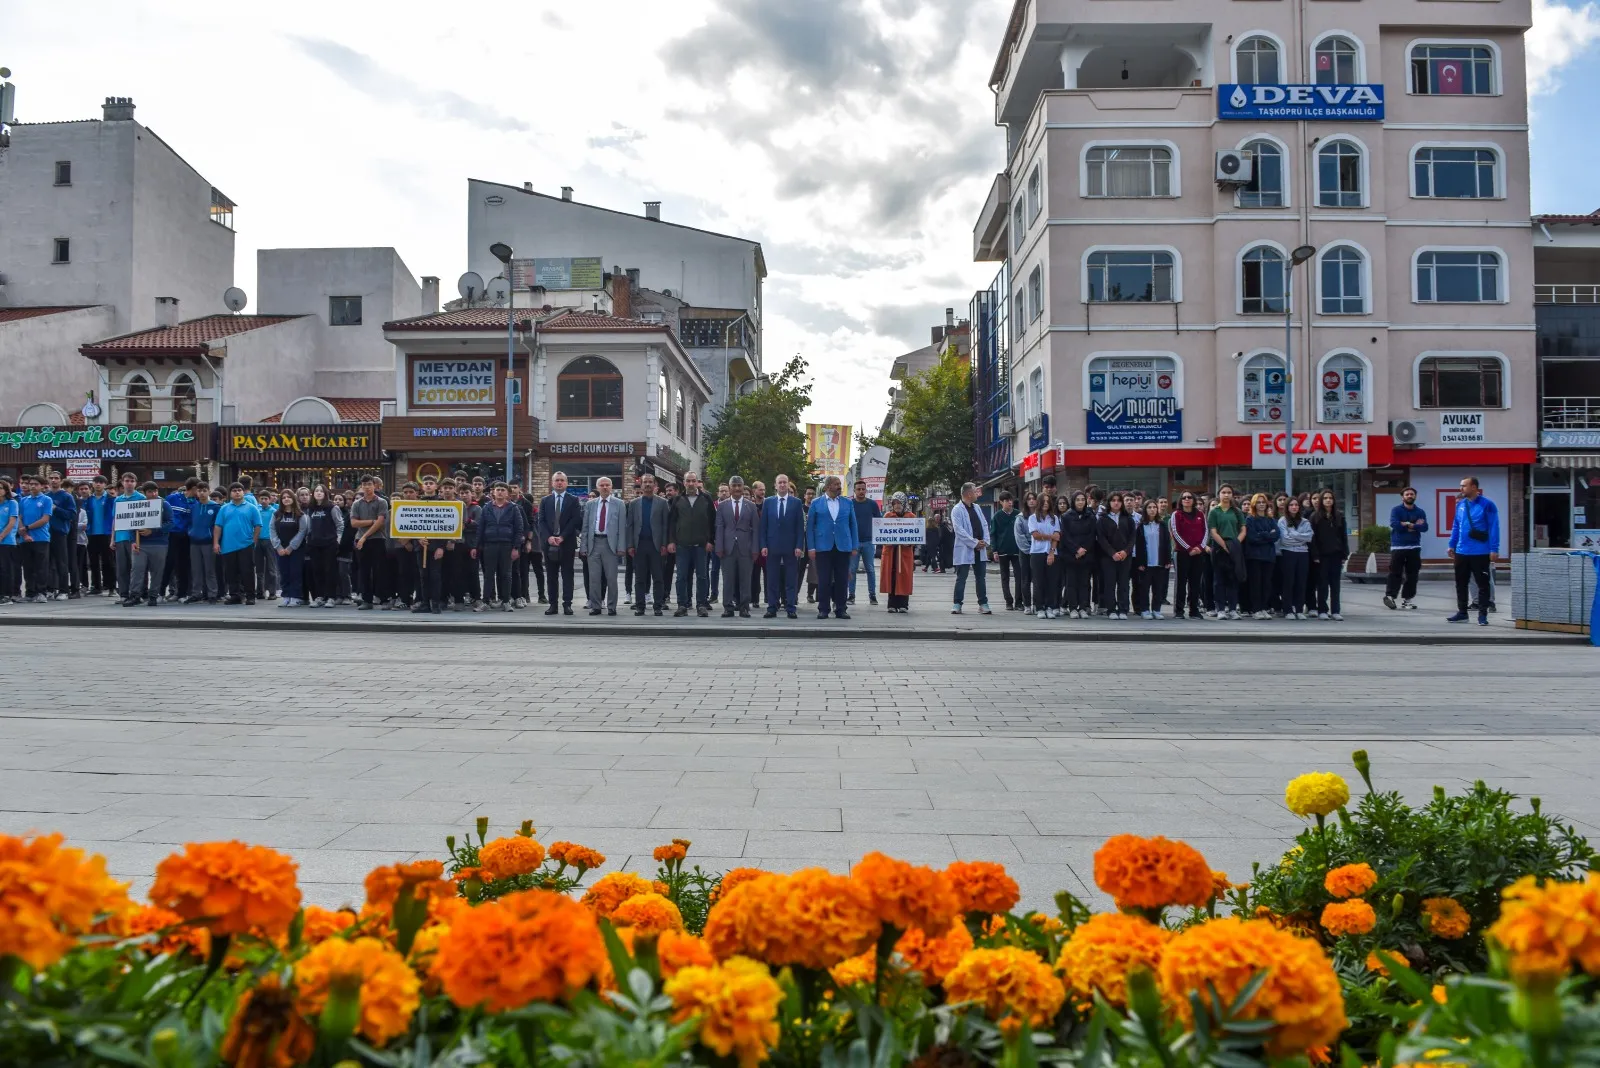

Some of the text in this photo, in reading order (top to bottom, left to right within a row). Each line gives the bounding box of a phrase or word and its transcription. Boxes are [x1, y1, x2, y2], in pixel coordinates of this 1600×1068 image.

[1252, 86, 1383, 105] DEVA
[1258, 107, 1376, 117] TAŞKÖPRÜ İLÇE BAŞKANLIĞI
[419, 362, 493, 373] MEYDAN
[418, 374, 493, 385] KIRTASİYE
[1112, 373, 1152, 389] hepiyi
[417, 386, 493, 402] FOTOKOPİ
[1126, 398, 1175, 417] MUMCU
[1442, 414, 1482, 425] AVUKAT
[0, 425, 194, 448] aşköprü Garlic
[413, 426, 498, 437] MEYDAN KIRTASİYE
[233, 433, 369, 453] PAŞAM TİCARET
[550, 442, 634, 454] CEBECİ KURUYEMİŞ
[1258, 433, 1363, 454] ECZANE
[37, 449, 132, 461] SARIMSAKÇI HOCA
[1296, 455, 1325, 466] EKİM
[116, 512, 135, 520] ANADOLU
